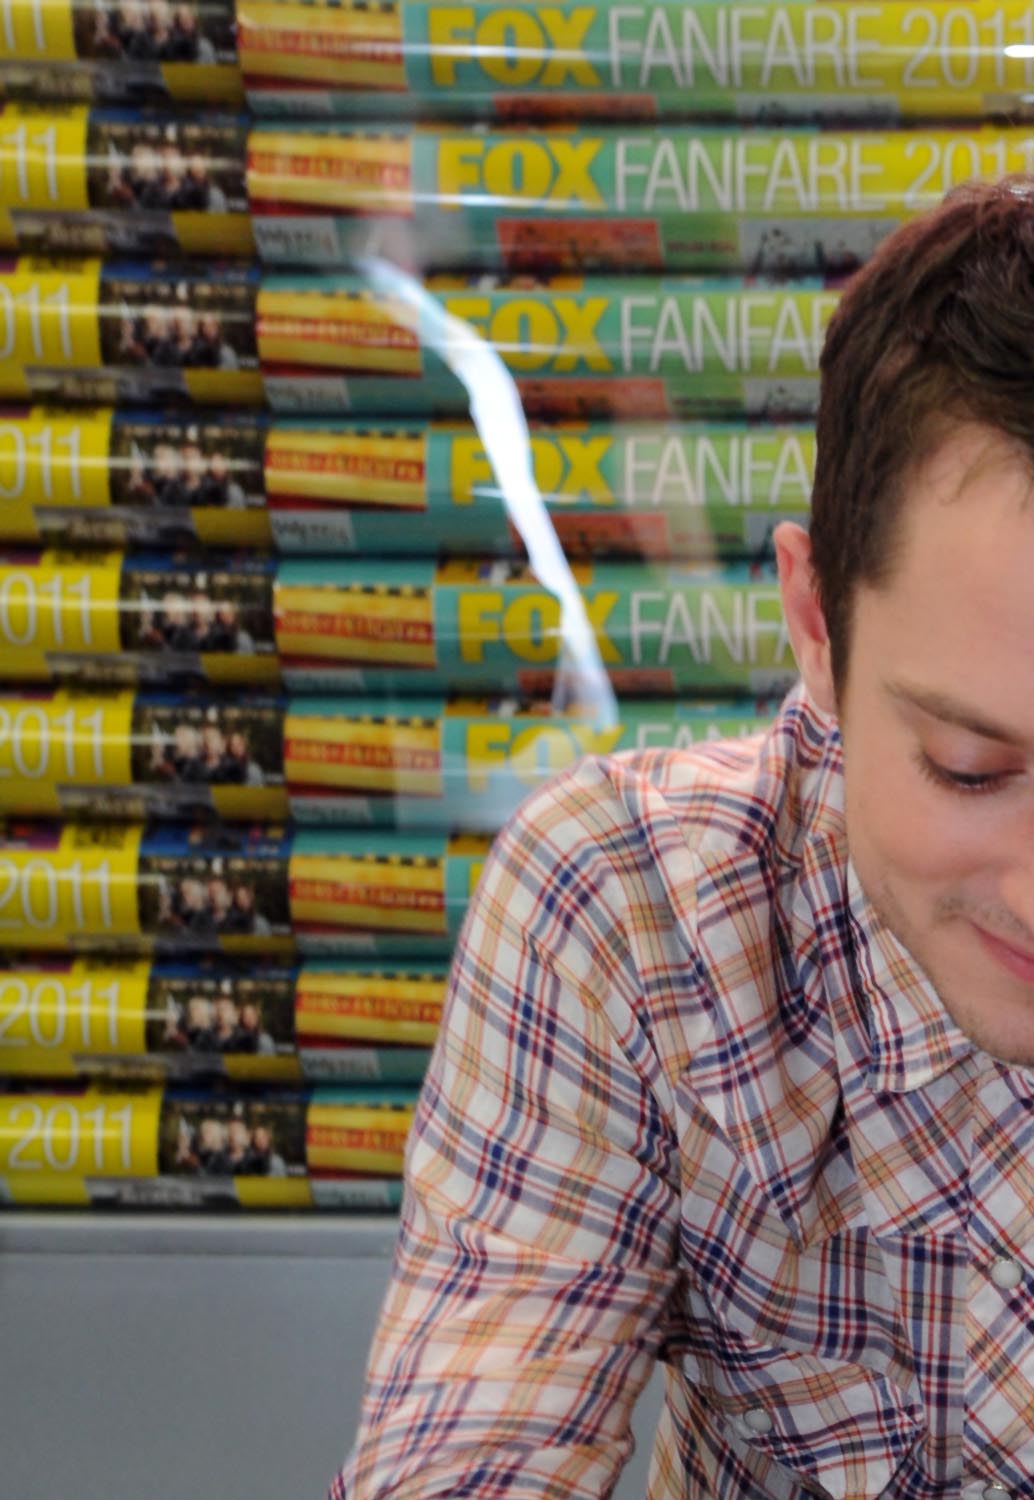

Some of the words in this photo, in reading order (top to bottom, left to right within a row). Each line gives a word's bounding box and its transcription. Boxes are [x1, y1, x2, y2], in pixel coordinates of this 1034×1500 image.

[429, 5, 598, 88] FOX
[608, 6, 886, 88] FANFARE
[437, 138, 608, 210] FOX
[614, 138, 886, 212] FANFARE
[620, 296, 838, 372] FANFA
[0, 424, 82, 498] 011
[623, 435, 815, 506] FANFA
[0, 573, 93, 645] 011
[629, 592, 792, 665] FANF
[0, 979, 120, 1048] 2011
[7, 1102, 133, 1170] 2011
